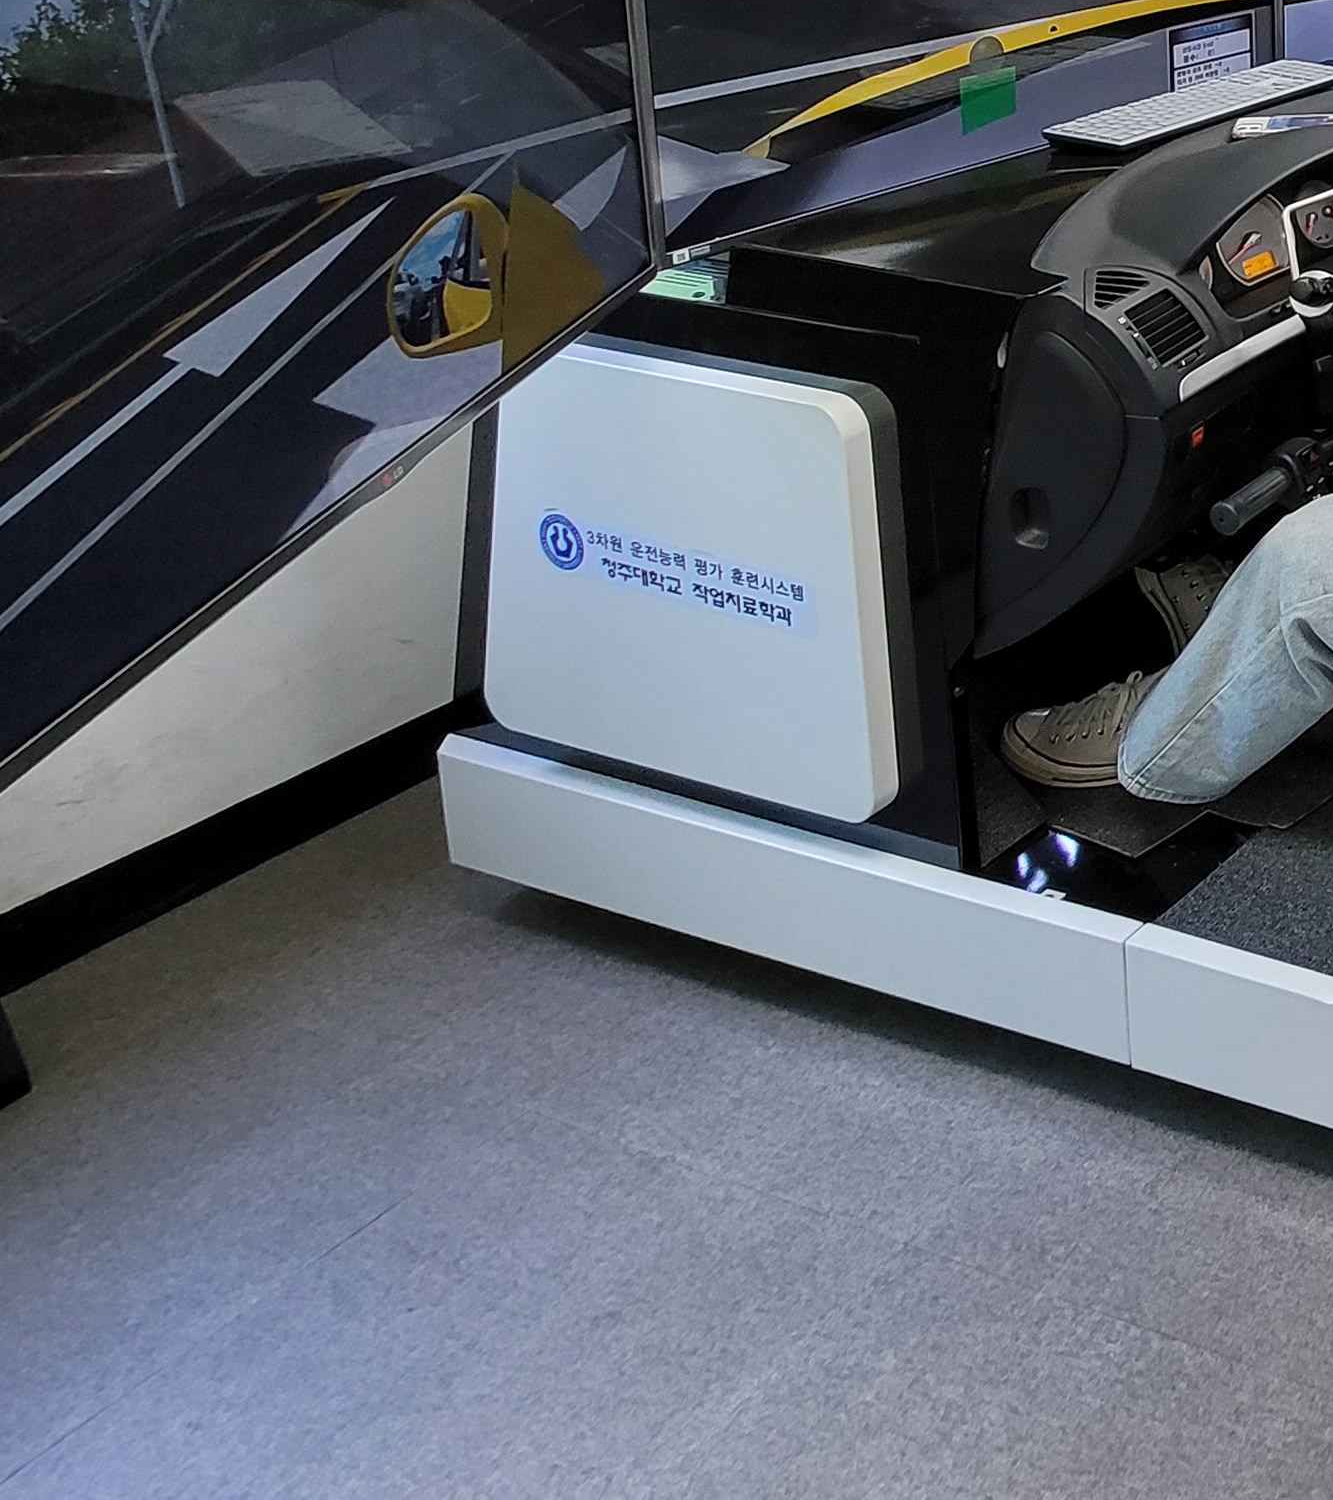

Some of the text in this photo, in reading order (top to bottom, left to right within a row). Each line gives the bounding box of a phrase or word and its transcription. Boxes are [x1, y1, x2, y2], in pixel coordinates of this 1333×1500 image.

[586, 531, 622, 553] 3차원
[630, 541, 686, 571] 운전능력
[695, 558, 723, 581] 평가
[731, 567, 804, 602] 훈련시스템
[601, 557, 792, 627] 청주대학교 작업치료학과
